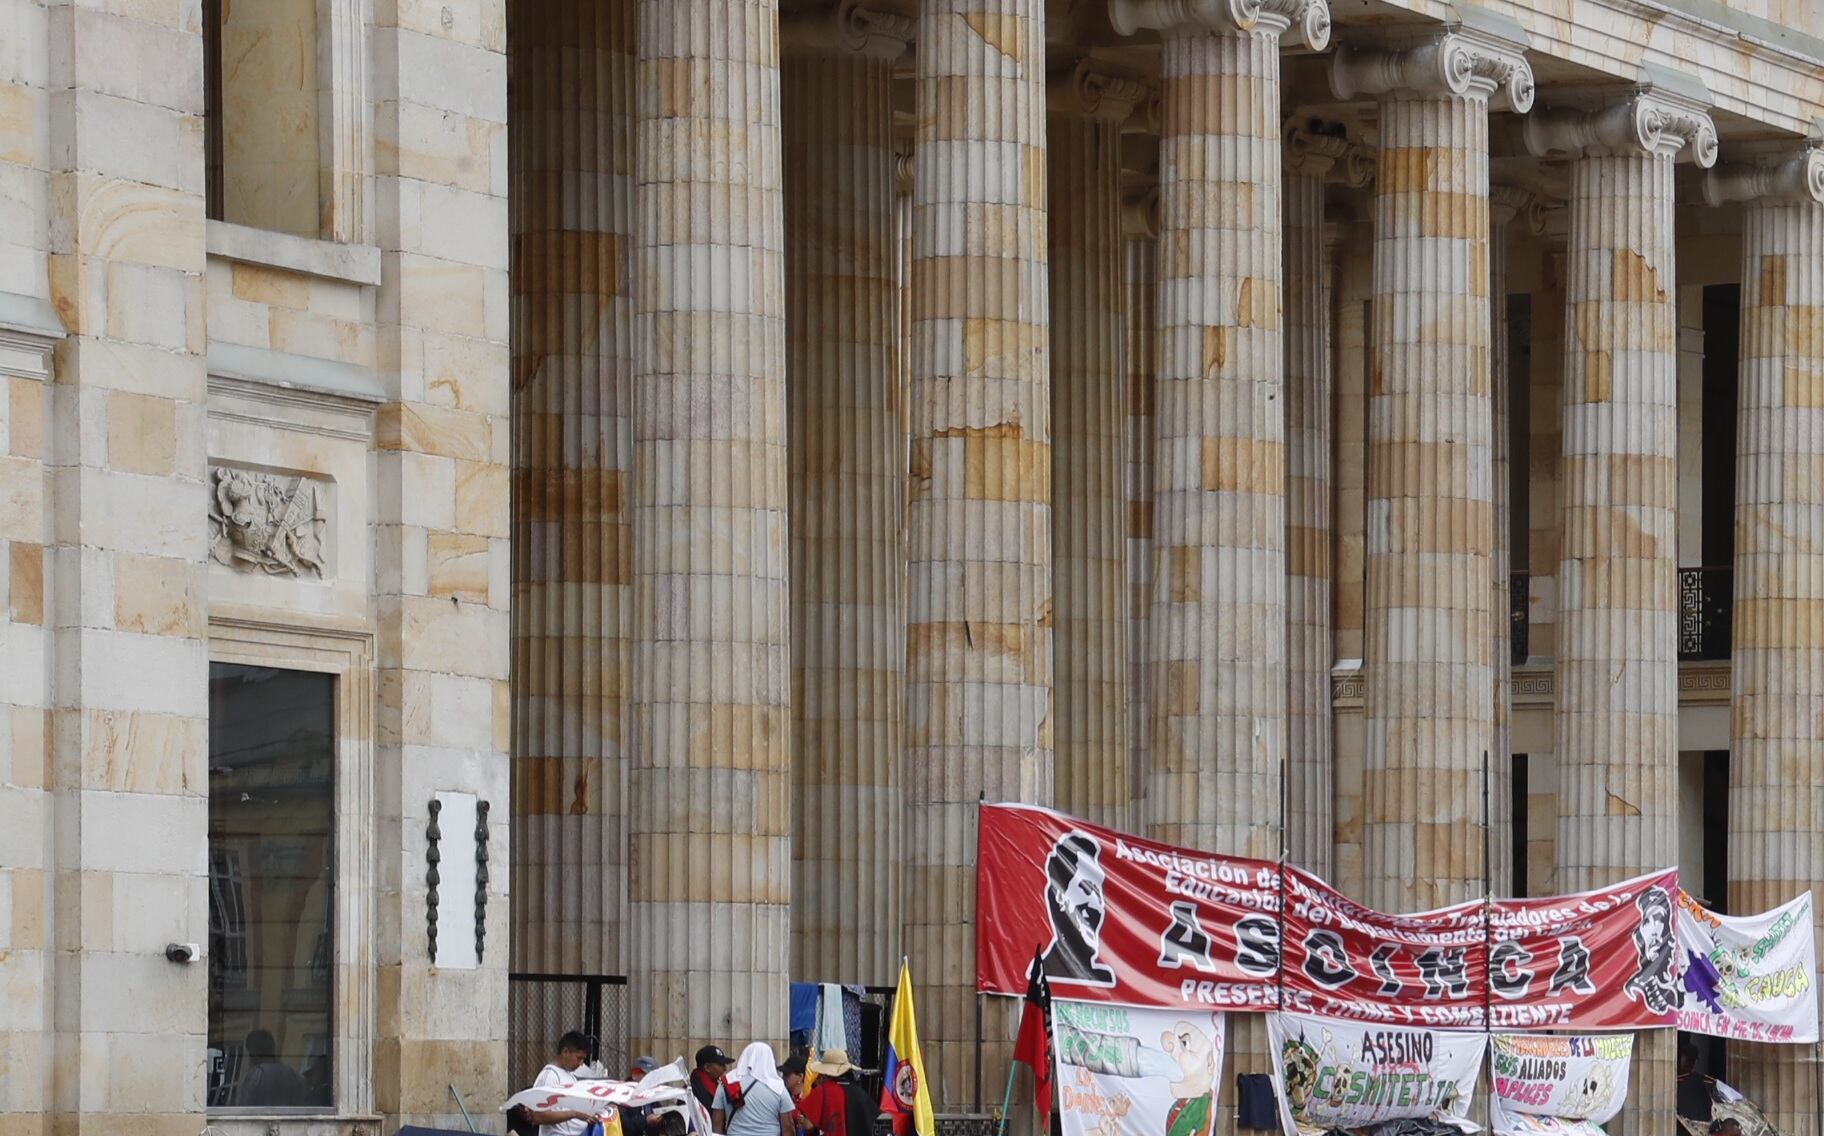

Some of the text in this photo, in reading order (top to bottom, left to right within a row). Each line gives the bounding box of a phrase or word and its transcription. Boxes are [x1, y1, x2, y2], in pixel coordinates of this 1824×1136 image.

[1116, 839, 1249, 885] Asociación
[1579, 896, 1610, 914] de
[1165, 869, 1285, 912] Educación
[1292, 899, 1333, 926] del
[1335, 911, 1486, 944] Departamento
[1157, 900, 1598, 1001] ASOINCA
[1745, 962, 1809, 1002] CAUCA
[1322, 997, 1395, 1022] FIRME
[1361, 1030, 1433, 1065] ASESINO
[1518, 1057, 1567, 1081] ALIADOS
[1497, 1077, 1554, 1106] PLICES
